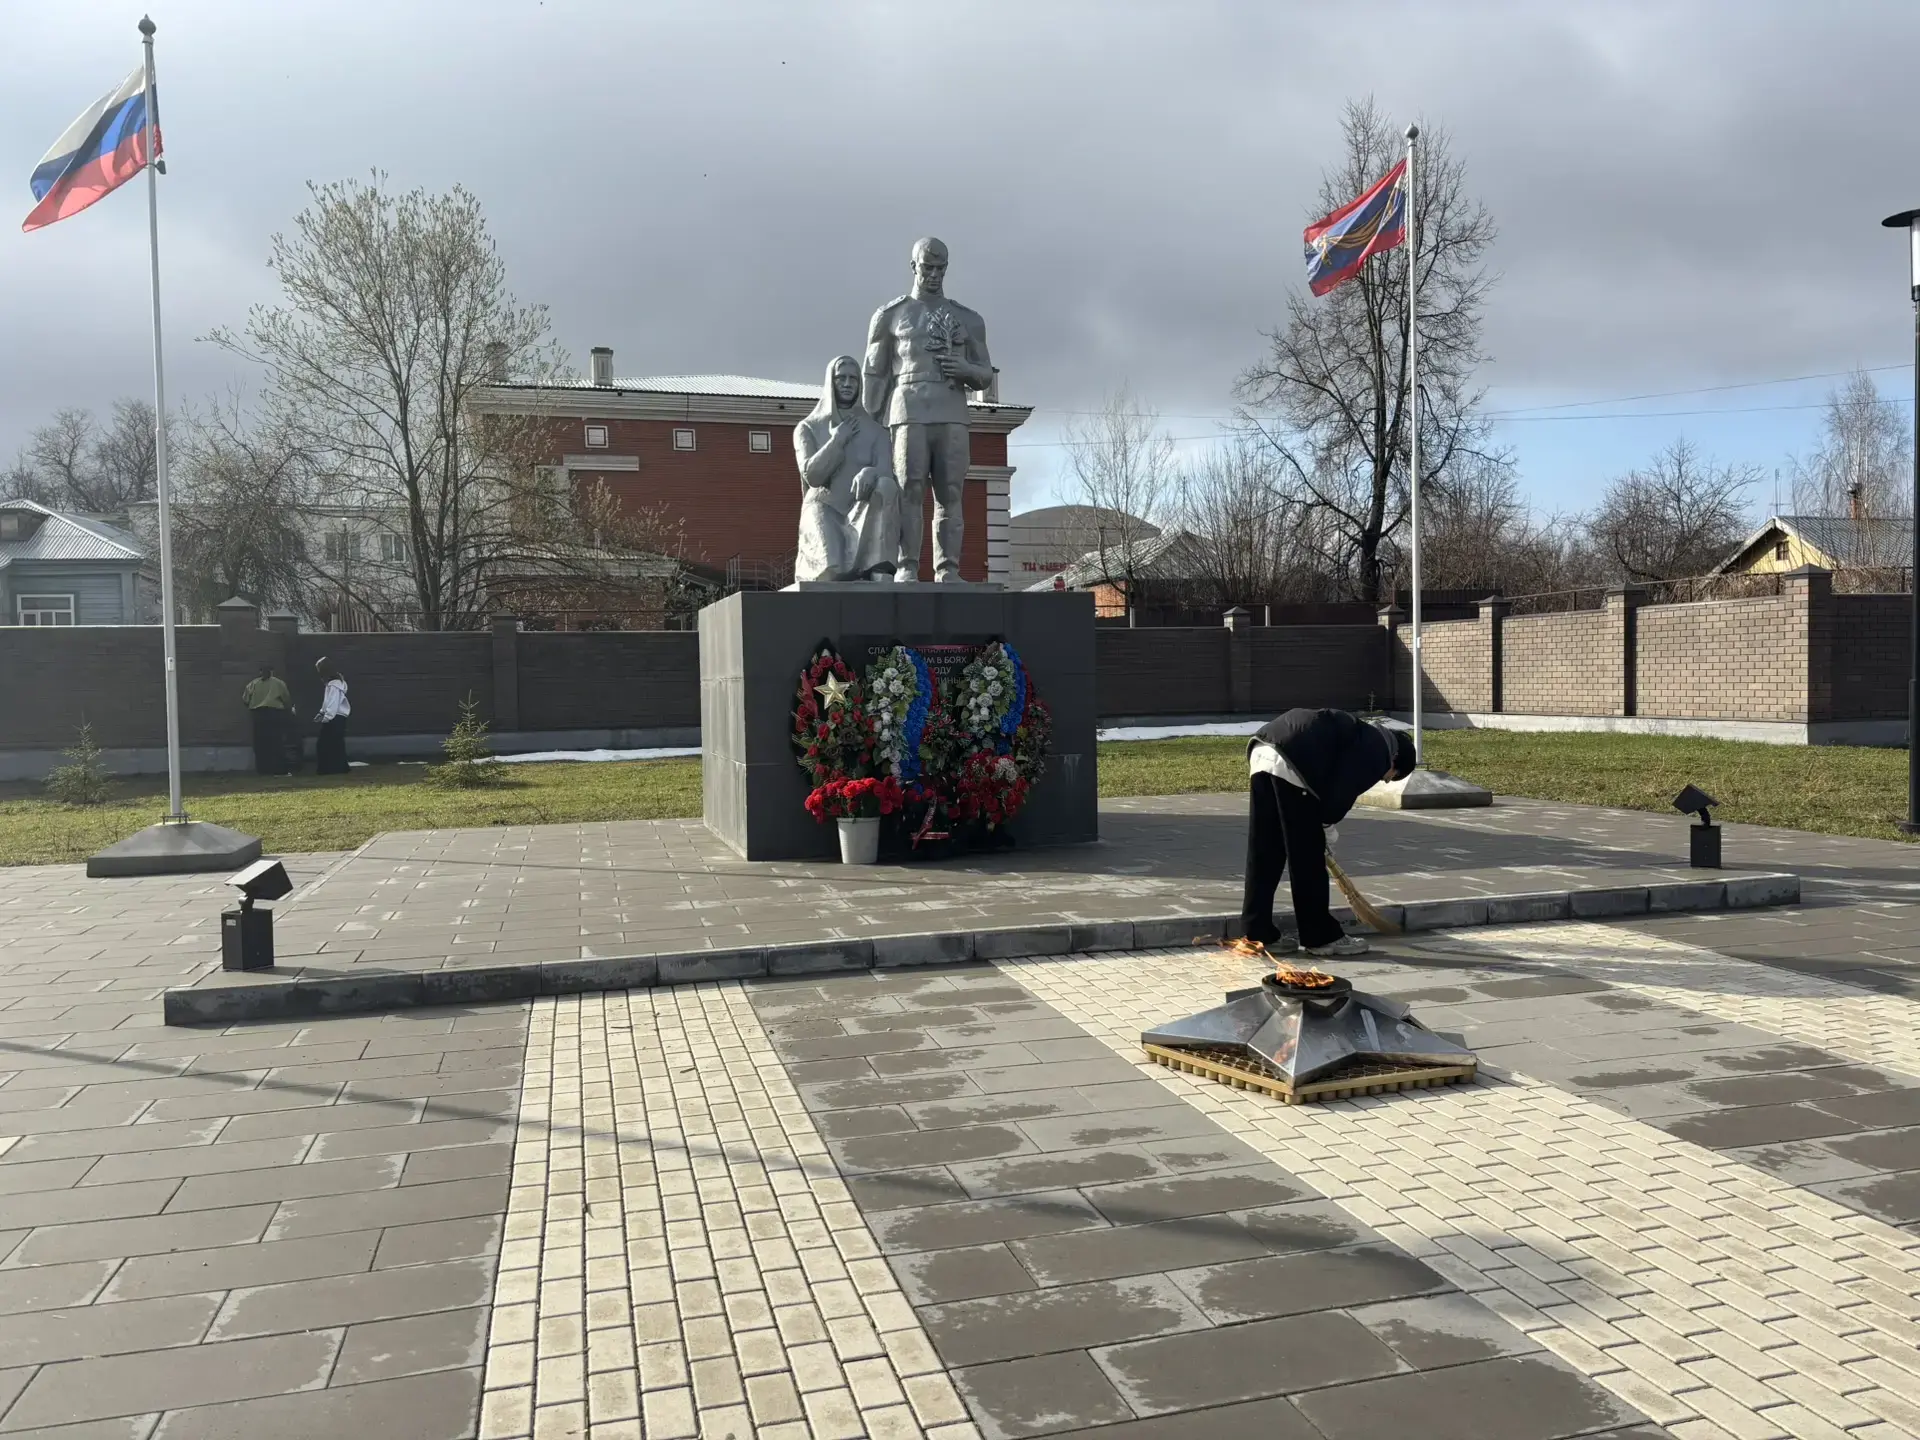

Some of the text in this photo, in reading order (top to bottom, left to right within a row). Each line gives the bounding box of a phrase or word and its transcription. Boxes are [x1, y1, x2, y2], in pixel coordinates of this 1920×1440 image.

[867, 646, 889, 655] СЛА
[936, 656, 943, 664] В
[944, 656, 968, 664] БОЯХ
